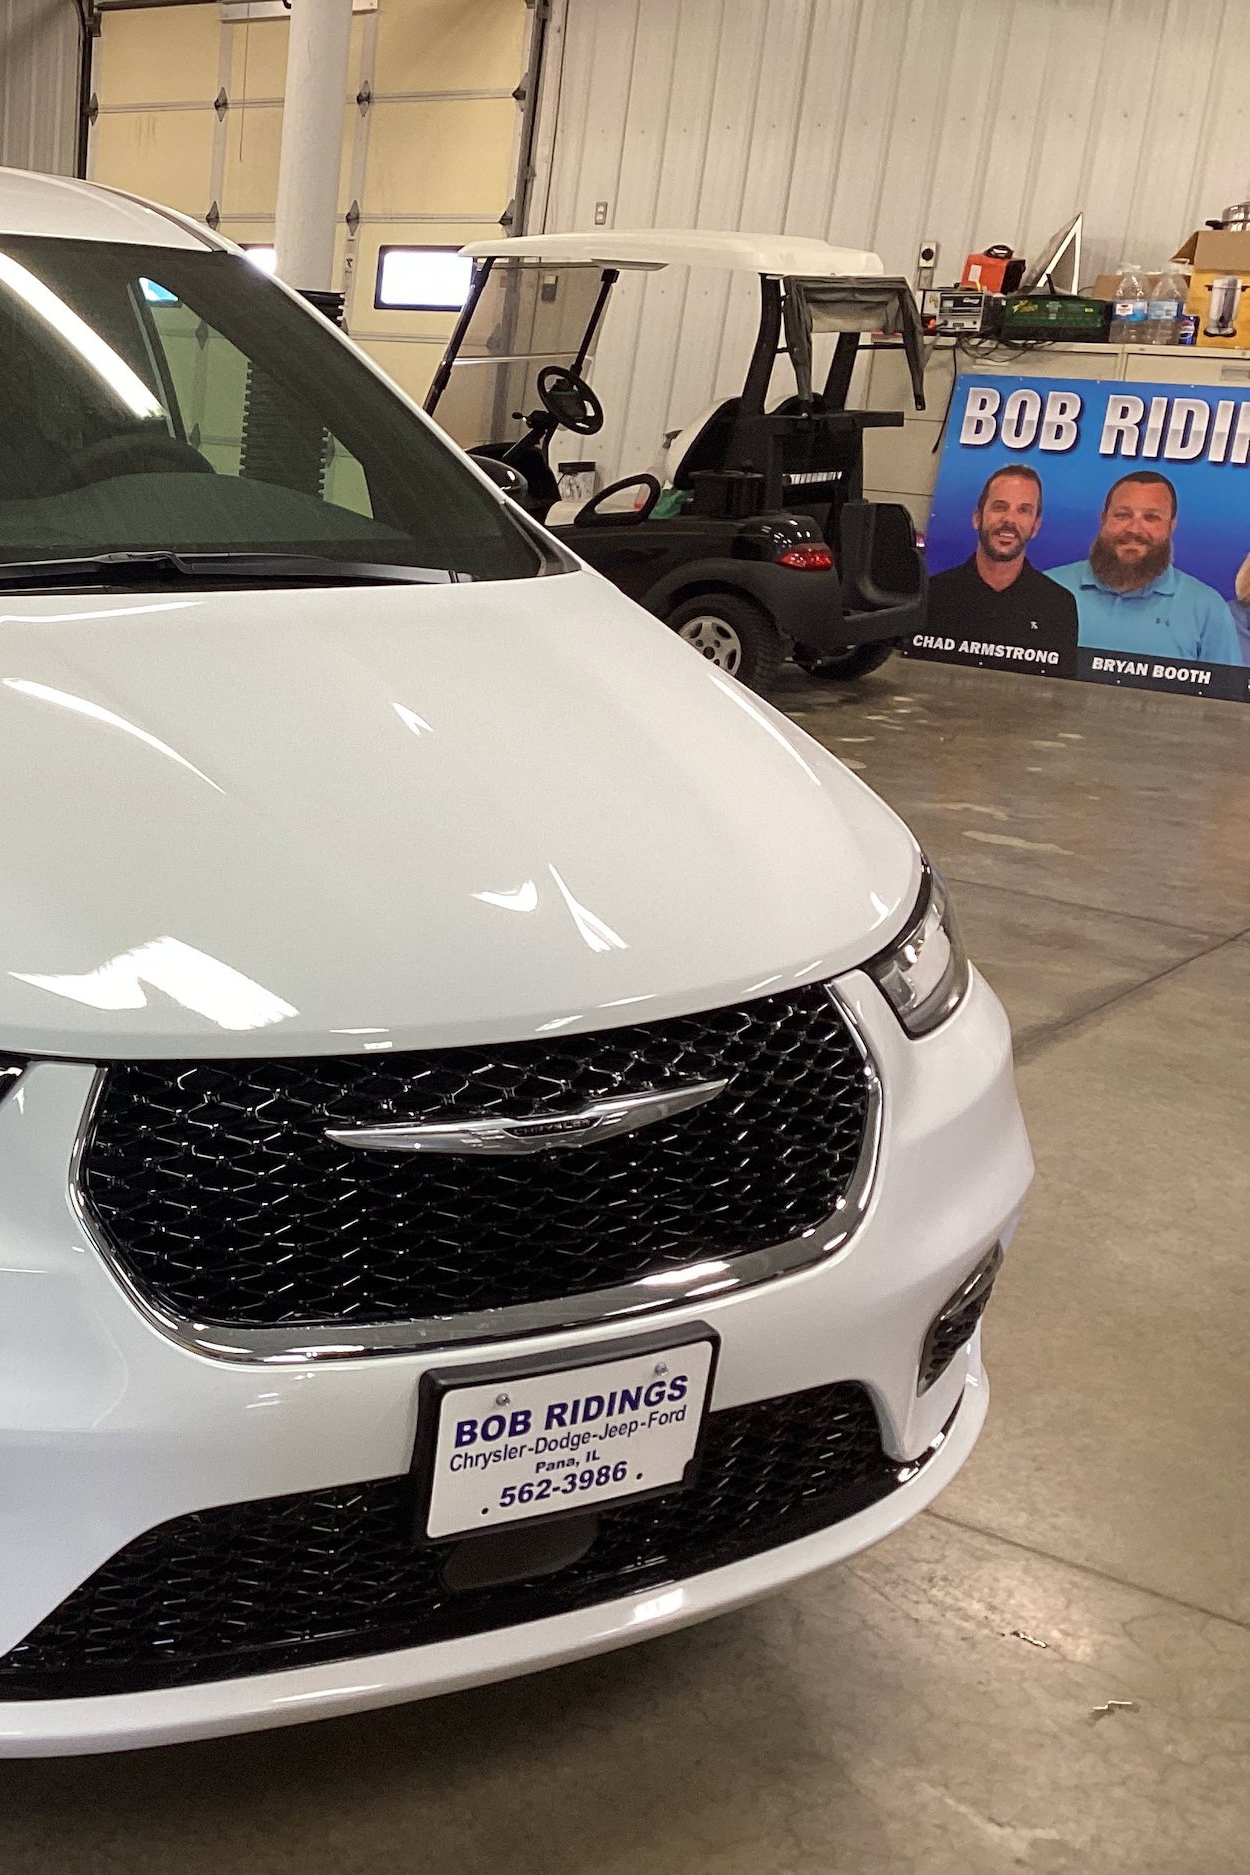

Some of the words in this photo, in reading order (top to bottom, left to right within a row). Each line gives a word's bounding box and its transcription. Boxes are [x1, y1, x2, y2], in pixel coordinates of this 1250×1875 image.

[959, 387, 1081, 452] BOB
[912, 634, 955, 652] CHAD
[958, 640, 1060, 665] ARMSTRONG
[1091, 657, 1148, 676] BRYAN
[1152, 665, 1211, 685] BOOTH
[453, 1409, 532, 1448] BOB
[544, 1375, 689, 1430] RIDINGS
[449, 1405, 687, 1472] Chrysler-Dodge-Jeep-Ford
[535, 1456, 580, 1473] Pana,
[585, 1450, 600, 1462] IL
[499, 1461, 628, 1507] 562-3986
